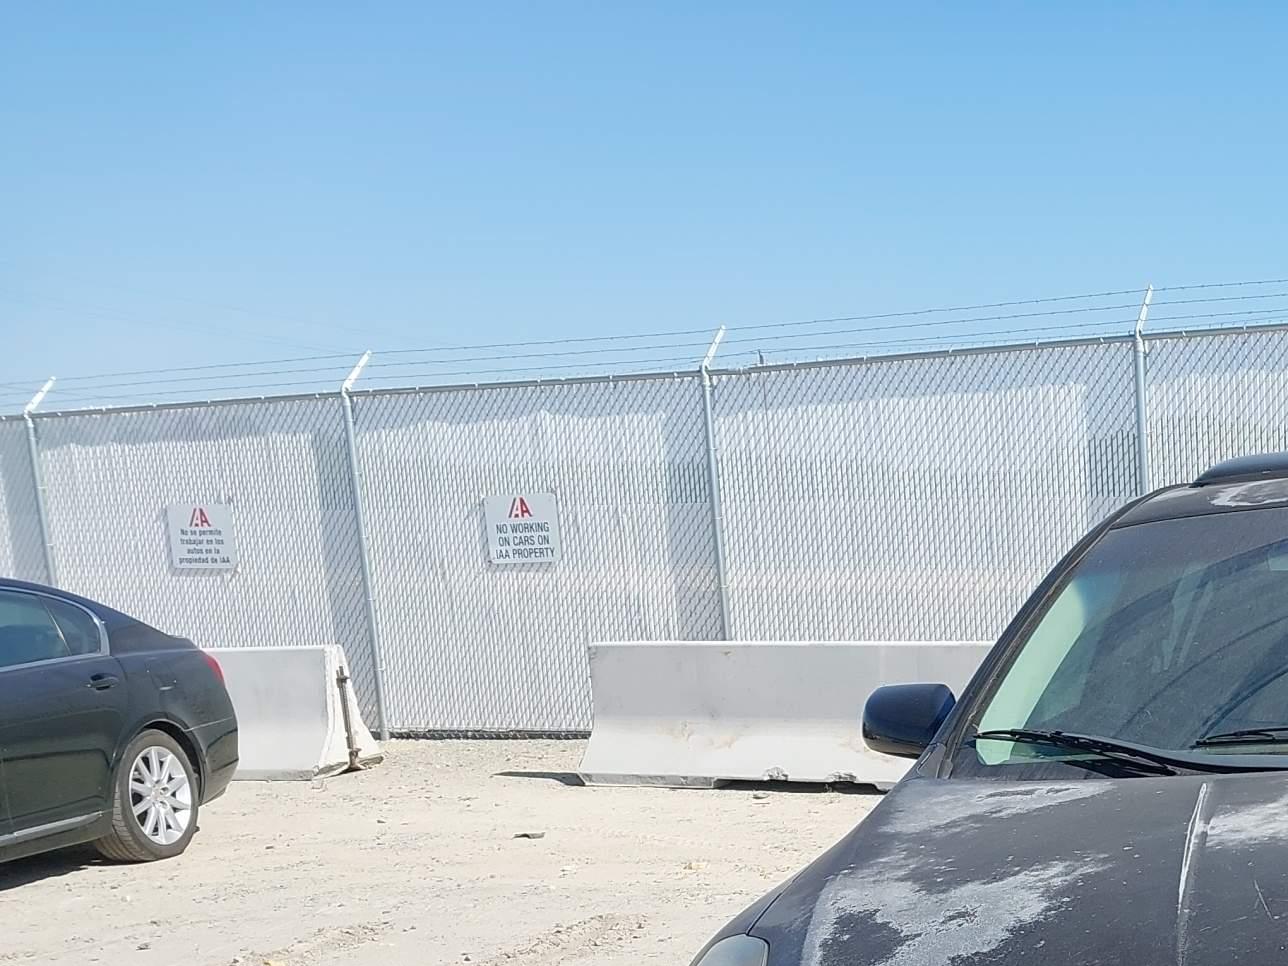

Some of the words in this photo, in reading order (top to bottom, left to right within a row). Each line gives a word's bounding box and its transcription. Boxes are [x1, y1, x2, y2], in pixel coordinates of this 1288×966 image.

[199, 529, 222, 537] permite
[496, 524, 508, 534] NO
[510, 522, 550, 533] WORKING
[498, 537, 510, 547] ON
[512, 535, 536, 546] CARS
[537, 534, 550, 545] ON
[496, 549, 510, 560] IAA
[512, 547, 555, 559] PROPERTY
